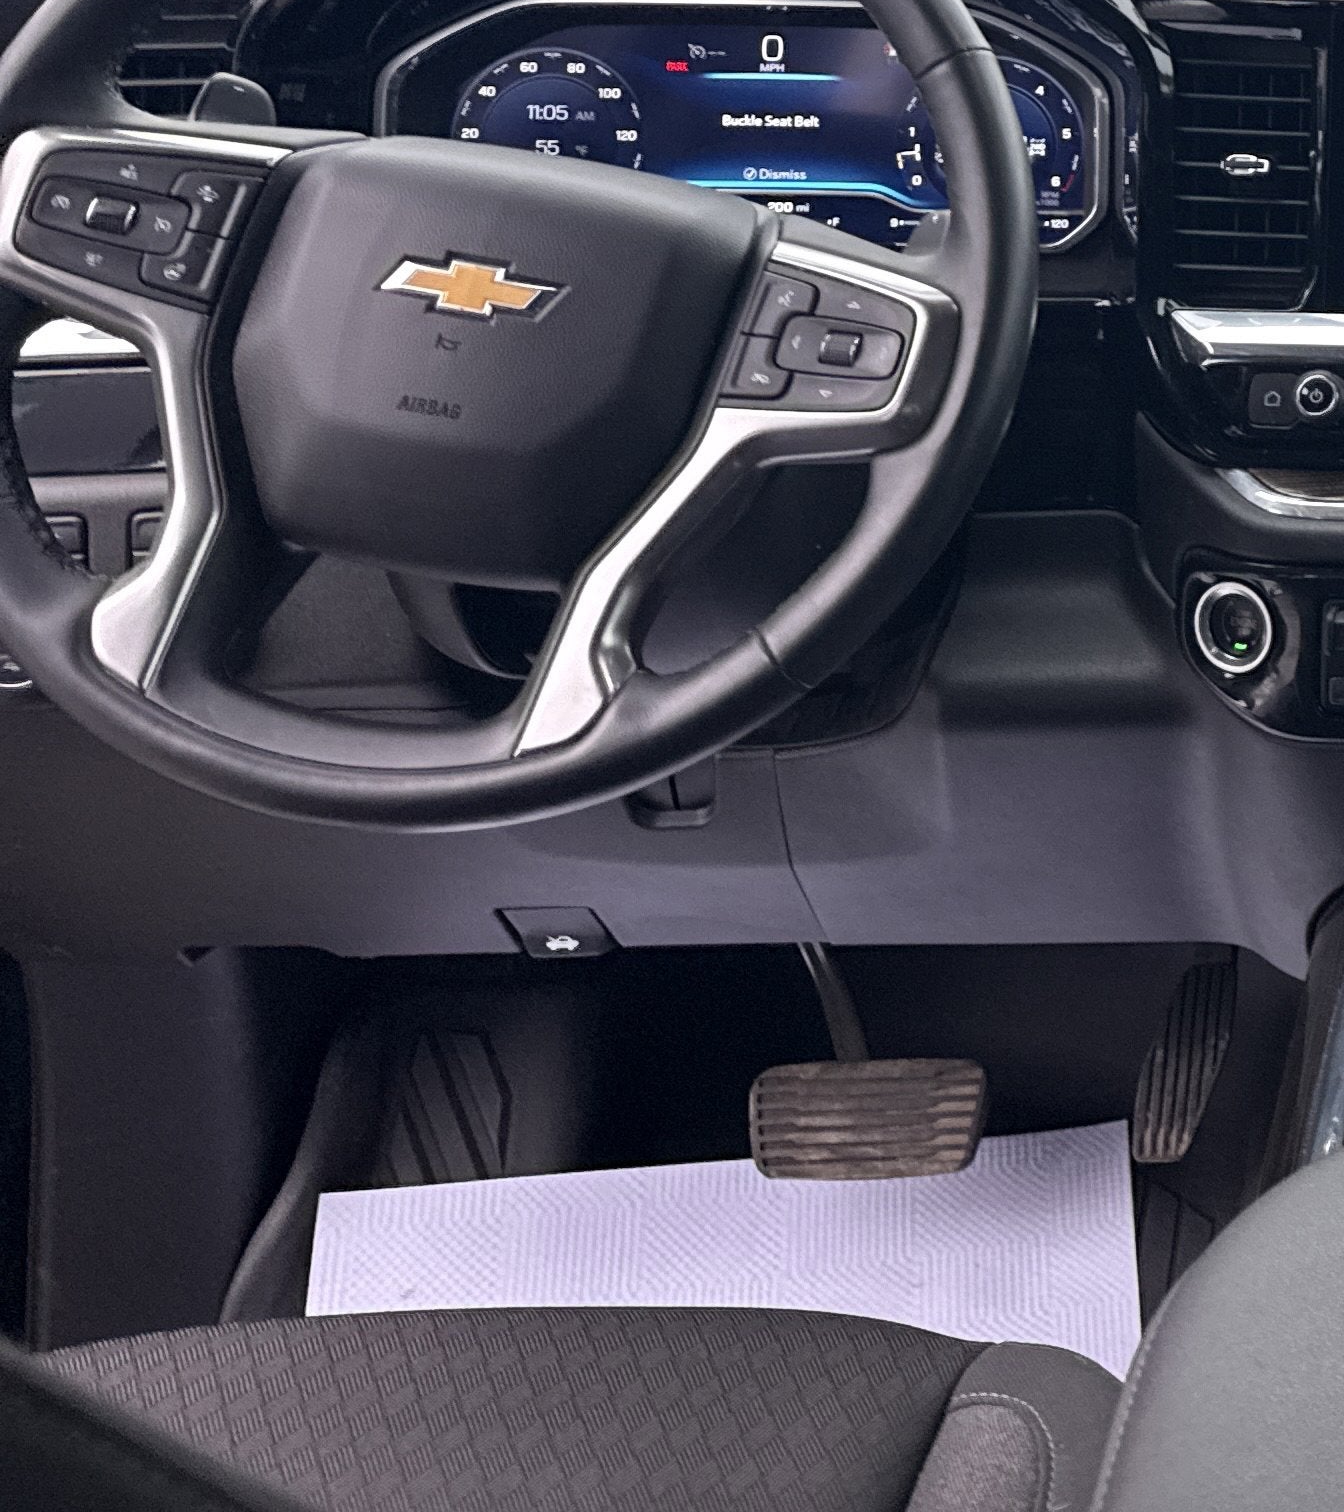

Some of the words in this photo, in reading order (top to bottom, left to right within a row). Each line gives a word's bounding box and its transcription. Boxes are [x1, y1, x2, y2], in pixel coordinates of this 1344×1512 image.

[761, 34, 784, 61] 0
[519, 62, 538, 73] 60
[567, 62, 586, 74] 80
[759, 63, 785, 73] MPH
[478, 86, 497, 97] 40
[598, 88, 621, 99] 100
[1035, 85, 1045, 96] 4
[526, 104, 569, 121] 11:05
[722, 114, 763, 128] Buckle
[764, 115, 793, 128] Seat
[794, 115, 820, 128] Belt
[461, 128, 479, 139] 20
[616, 130, 638, 142] 120
[1062, 128, 1072, 139] 5
[759, 168, 807, 180] Dismiss
[912, 175, 922, 186] 0
[1051, 176, 1061, 187] 6
[795, 202, 810, 213] mi
[396, 395, 462, 420] AIRBAG
